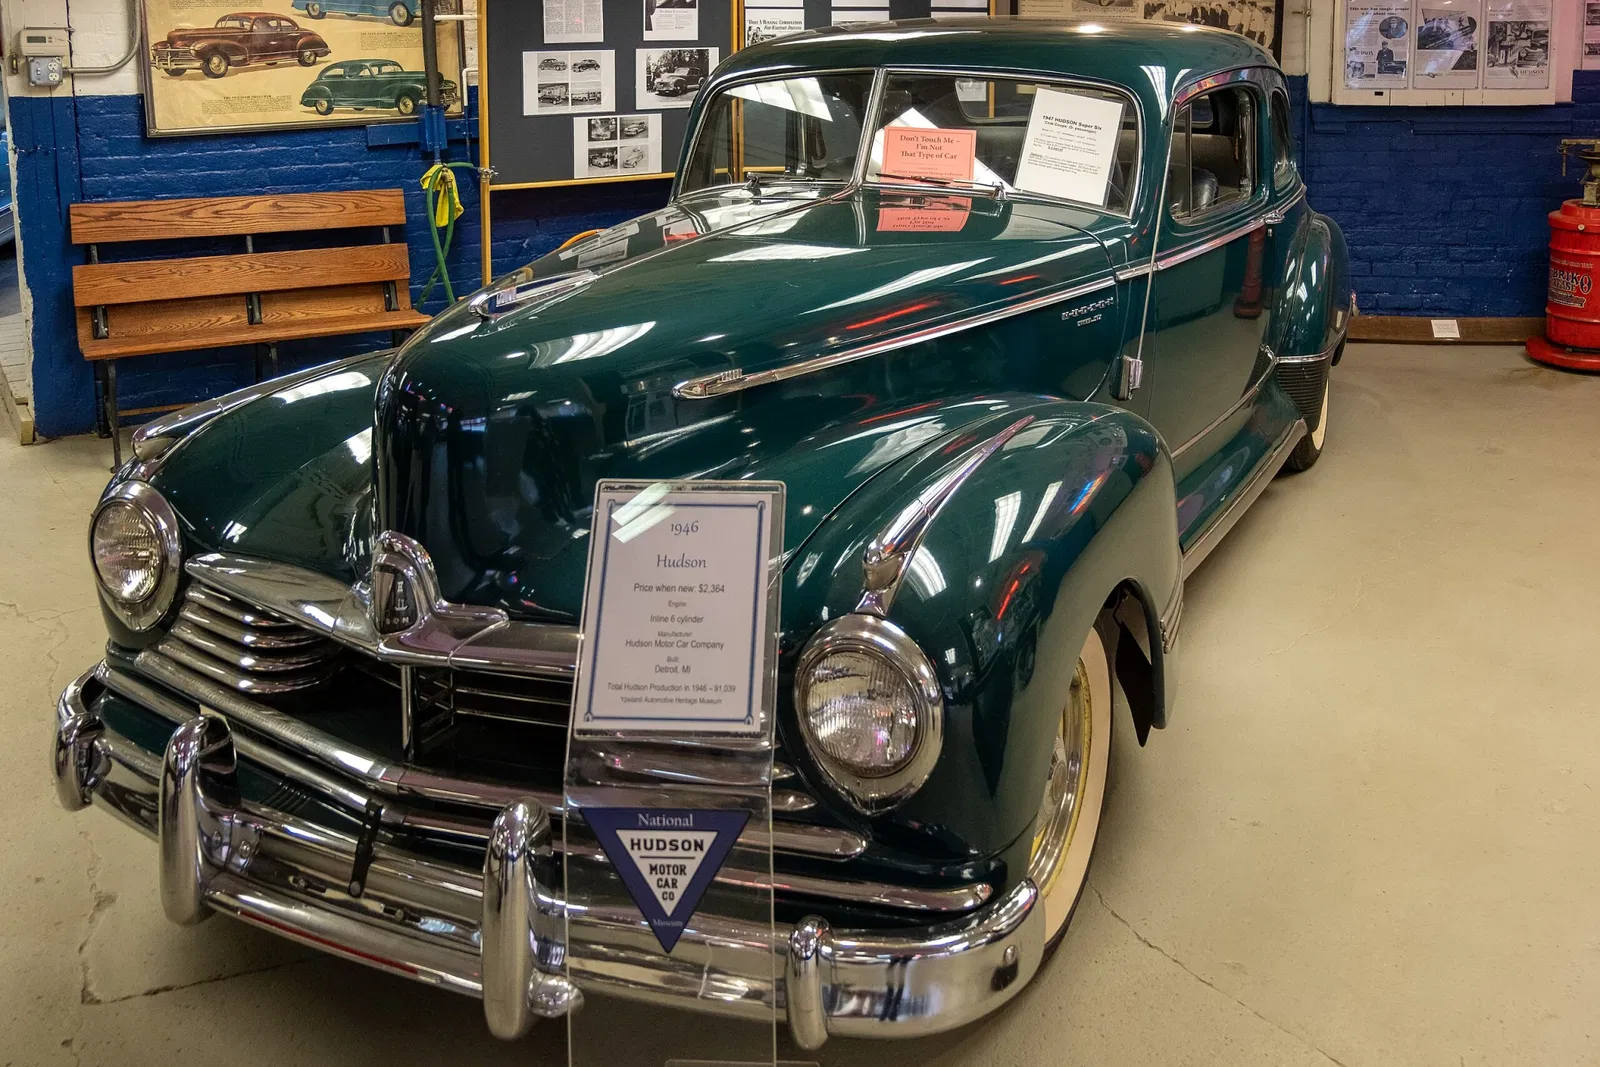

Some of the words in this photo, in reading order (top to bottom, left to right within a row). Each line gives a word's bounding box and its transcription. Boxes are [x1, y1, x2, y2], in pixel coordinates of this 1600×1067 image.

[1055, 117, 1078, 126] HUDSON
[670, 521, 699, 536] 1946
[656, 554, 707, 568] Hudson
[634, 583, 653, 592] Price
[655, 584, 676, 592] when
[698, 584, 725, 594] $2,364
[650, 615, 669, 623] Inline
[677, 615, 704, 624] cylinder
[625, 640, 652, 648] Hudson
[655, 640, 674, 648] Motor
[691, 641, 724, 650] Company
[650, 683, 683, 691] Production
[638, 814, 693, 827] National
[630, 838, 704, 852] HUDSON
[649, 864, 686, 875] MOTOR
[657, 878, 678, 889] CAR
[662, 891, 674, 901] CO
